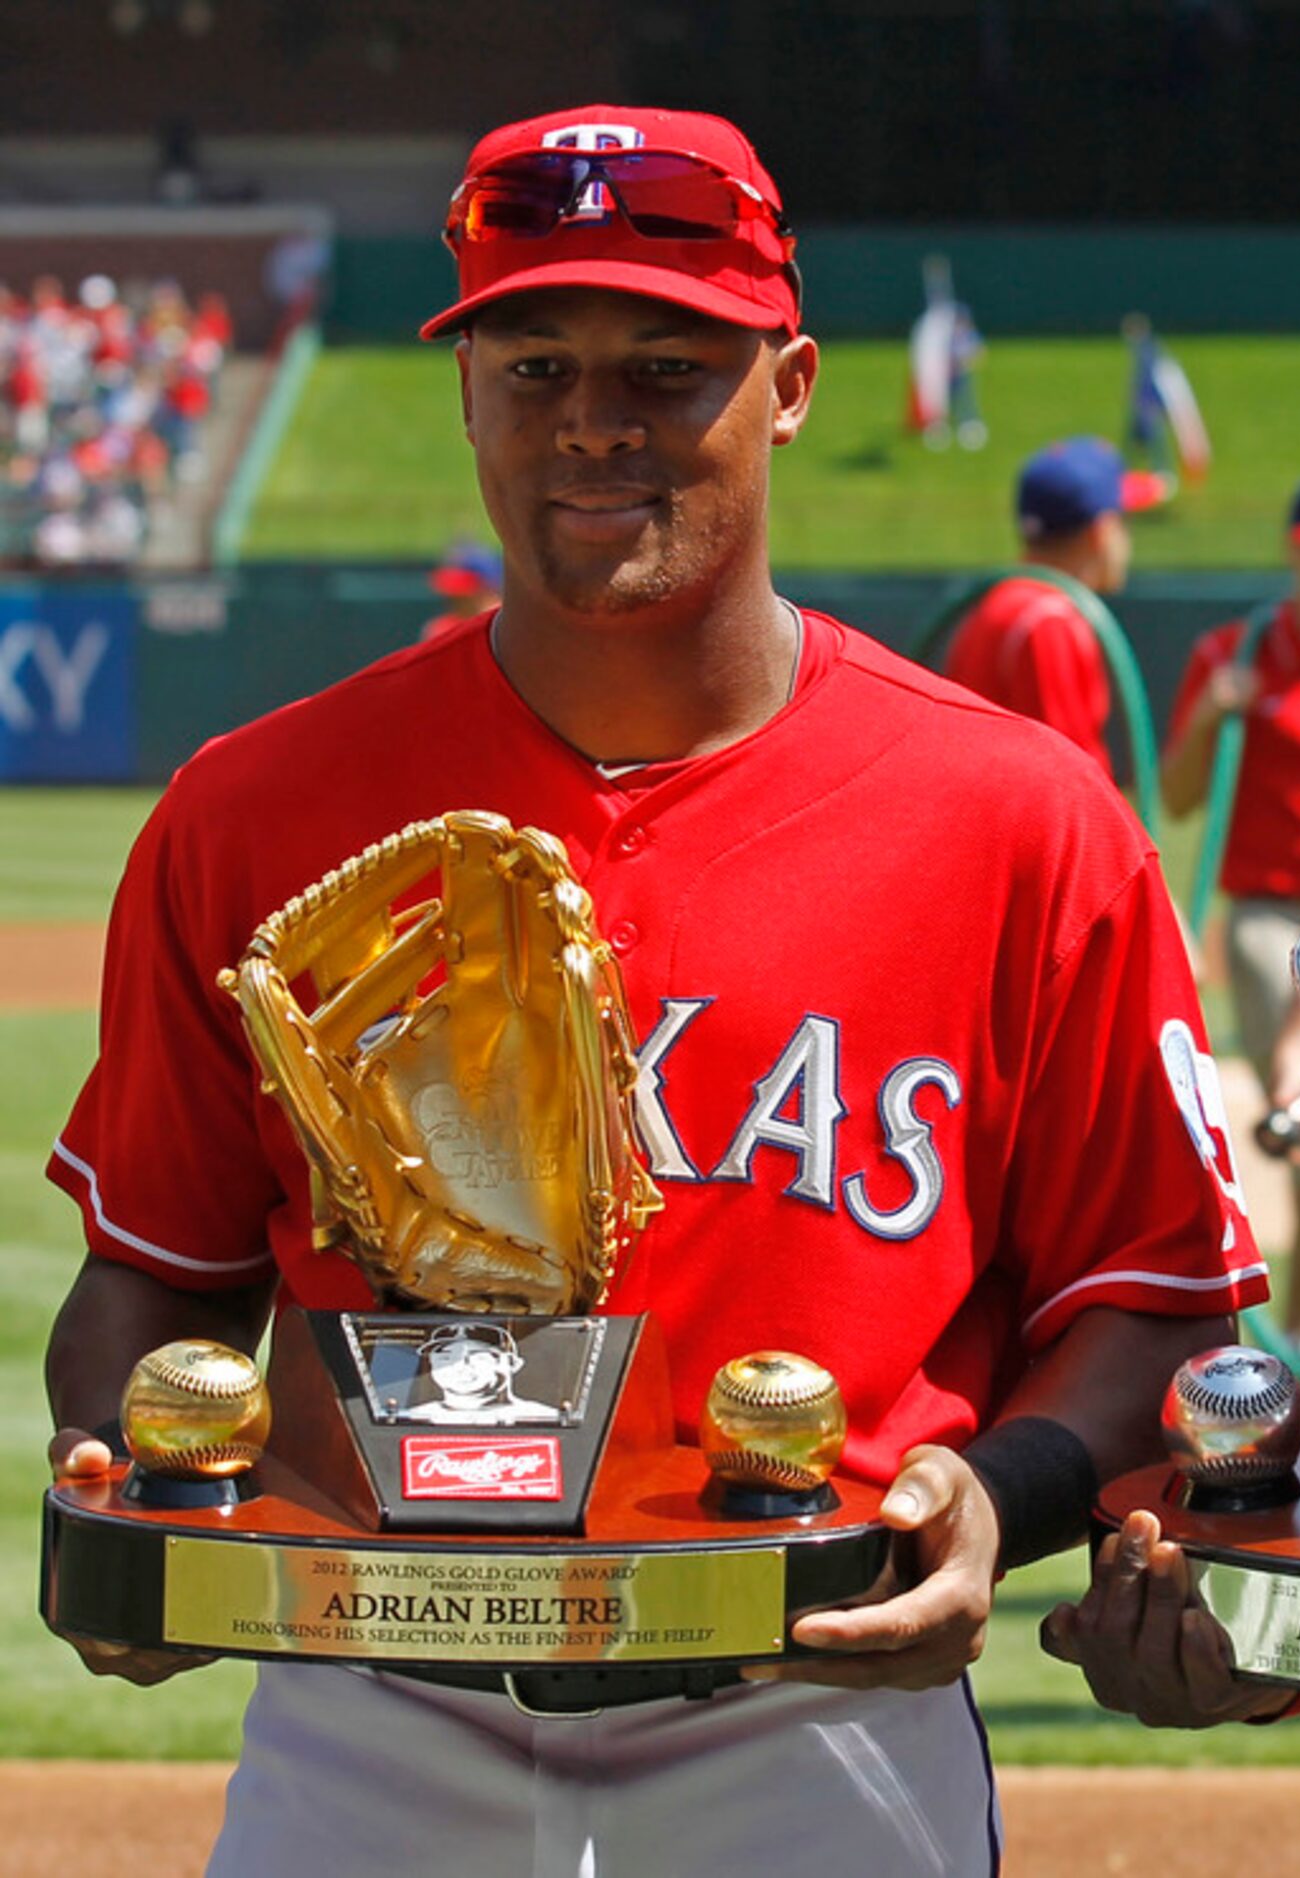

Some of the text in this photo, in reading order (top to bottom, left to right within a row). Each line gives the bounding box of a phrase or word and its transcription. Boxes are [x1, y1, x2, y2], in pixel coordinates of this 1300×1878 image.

[312, 1560, 348, 1576] 2012
[352, 1563, 446, 1580] RAWLINGS
[449, 1566, 501, 1580] GOLD
[504, 1567, 564, 1581] GLOVE
[501, 1582, 516, 1592] TO
[322, 1592, 623, 1625] ADRIAN BELTRE
[232, 1619, 331, 1640] HONORING
[335, 1626, 364, 1642] HIS
[368, 1628, 466, 1645] SELECTION
[470, 1630, 490, 1645] AS
[494, 1631, 532, 1646] THE
[536, 1630, 598, 1646] FINEST
[601, 1629, 621, 1645] IN
[624, 1629, 660, 1644] THE
[1257, 1654, 1281, 1671] THE
